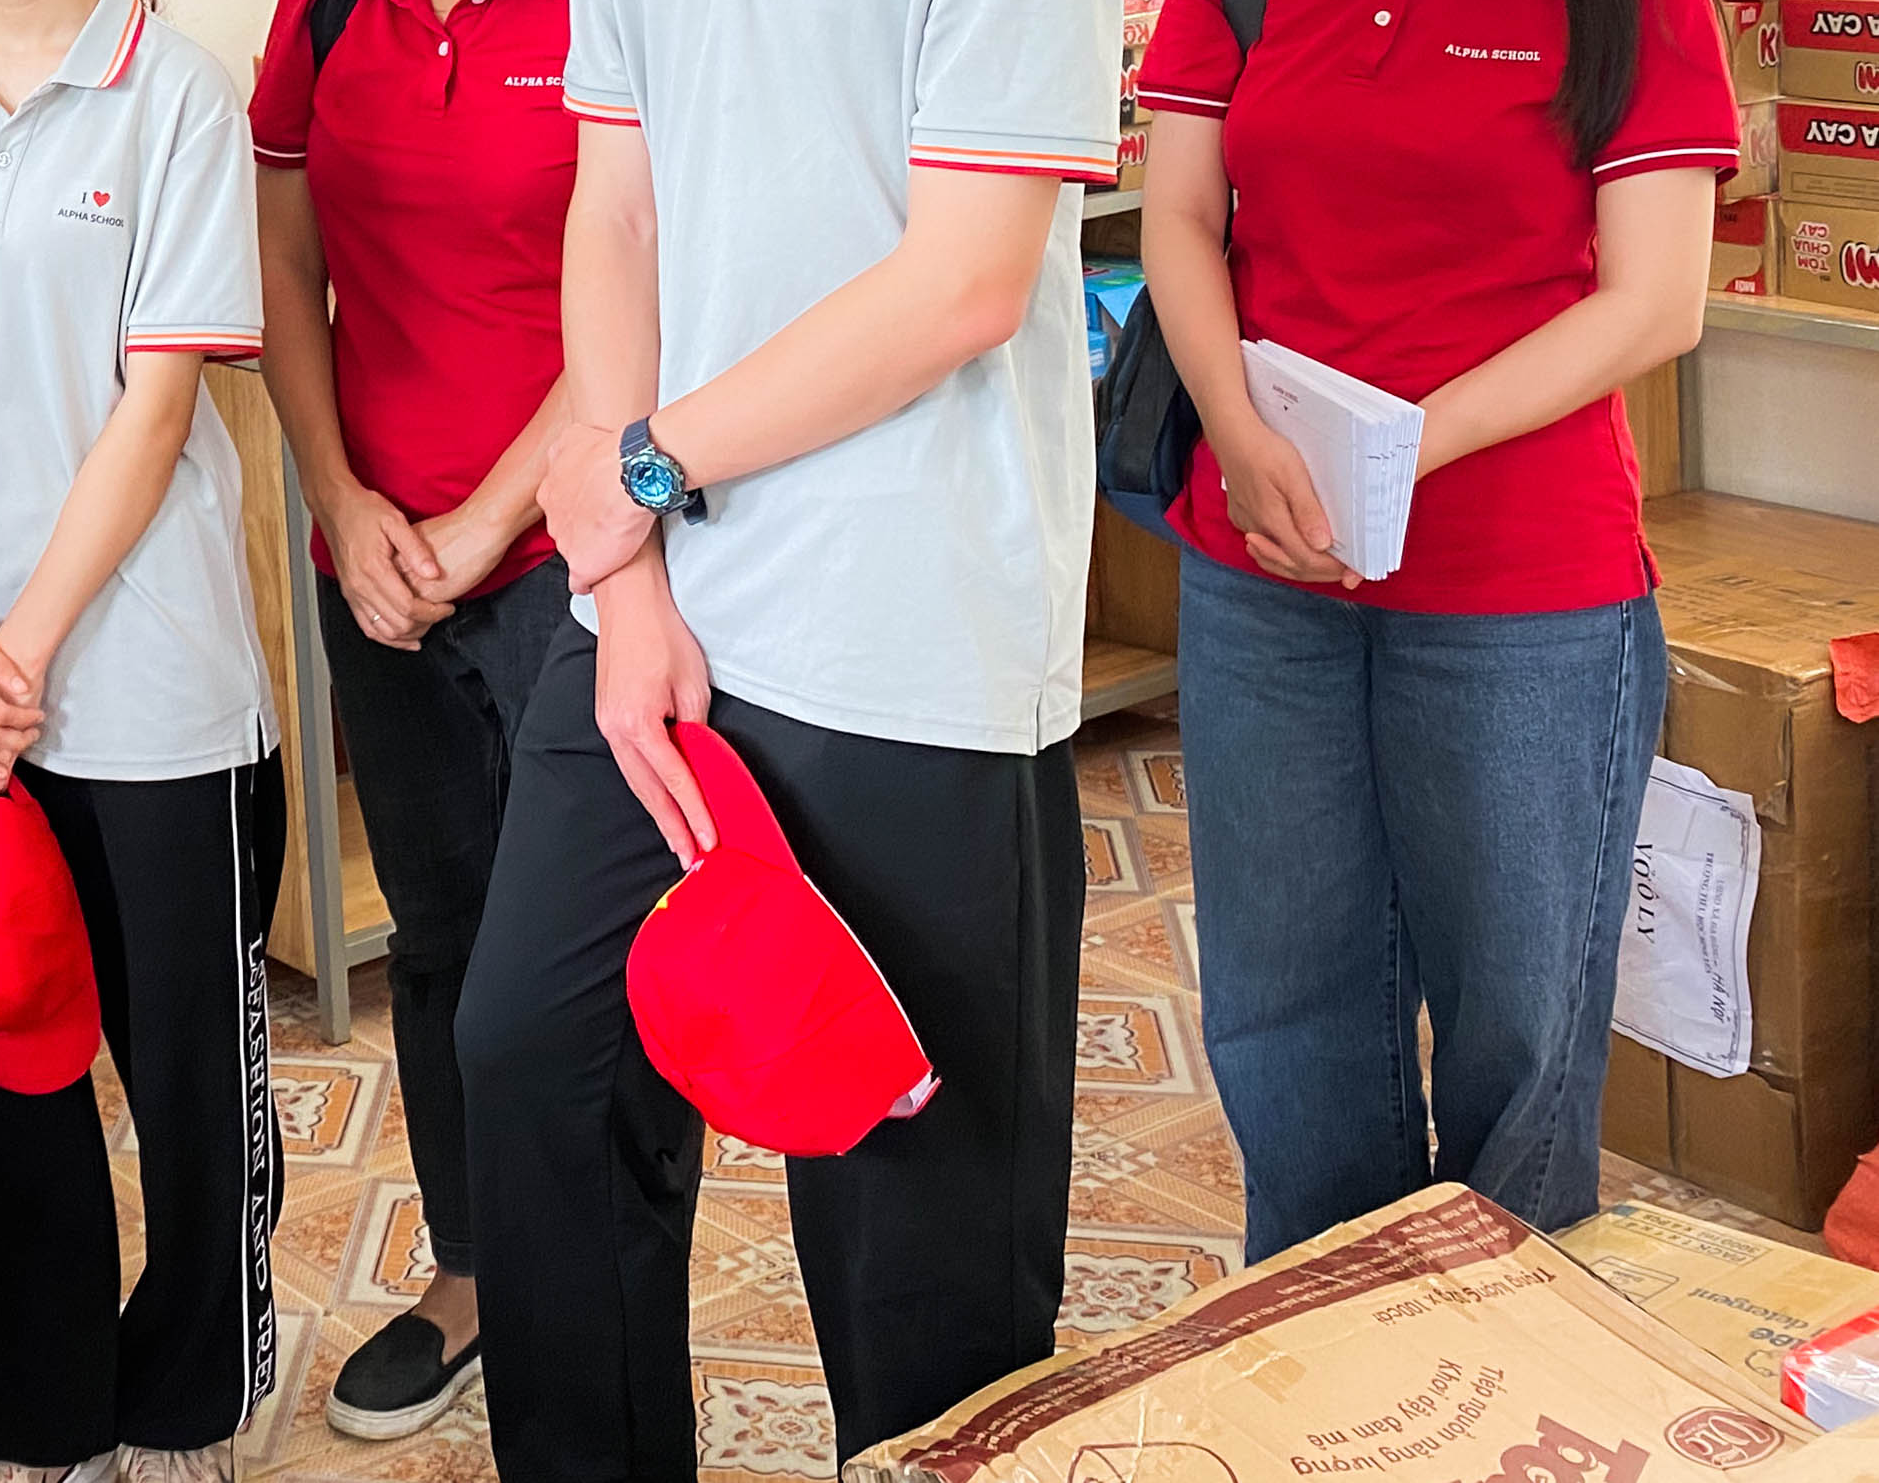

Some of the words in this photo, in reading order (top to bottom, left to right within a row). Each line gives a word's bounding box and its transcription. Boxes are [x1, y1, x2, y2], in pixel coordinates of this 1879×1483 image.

[1812, 12, 1862, 35] CAY
[1444, 44, 1488, 59] ALPHA
[1491, 49, 1541, 61] SCHOOL
[504, 76, 543, 87] ALPHA
[1806, 120, 1856, 145] CAY
[58, 208, 88, 221] ALPHA
[90, 214, 124, 228] SCHOOL
[1798, 223, 1828, 238] CAY
[1792, 238, 1832, 256] CHUA
[251, 1193, 268, 1292] AND
[1697, 1244, 1748, 1263] PACK
[1688, 1288, 1809, 1328] detergent
[1431, 1357, 1463, 1401] Khơi
[1470, 1365, 1508, 1398] Tiếp
[1397, 1393, 1439, 1421] dậy
[1437, 1397, 1487, 1441] nguồn
[1352, 1415, 1403, 1440] đam
[1306, 1430, 1350, 1451] mê
[1378, 1435, 1443, 1464] năng
[1290, 1453, 1387, 1476] lượng
